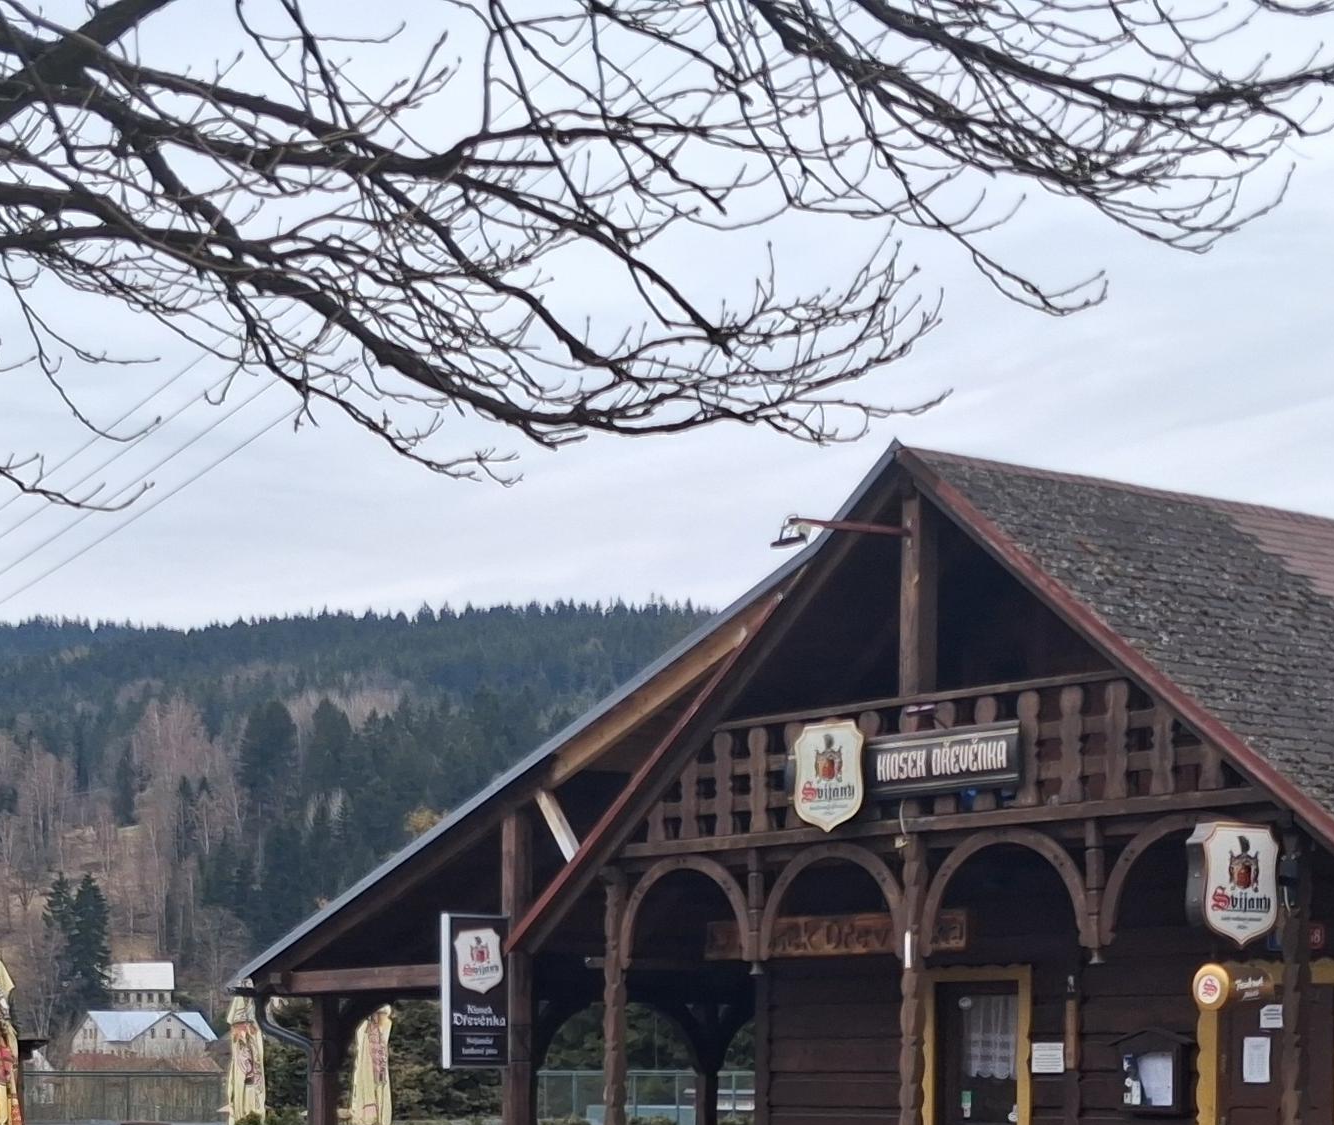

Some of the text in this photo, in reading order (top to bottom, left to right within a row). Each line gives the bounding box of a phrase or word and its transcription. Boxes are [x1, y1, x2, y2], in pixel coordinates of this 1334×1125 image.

[876, 737, 1007, 782] KIOSEK DŘEVĚNKA
[801, 780, 855, 804] Svijany
[1211, 885, 1271, 912] Svijany
